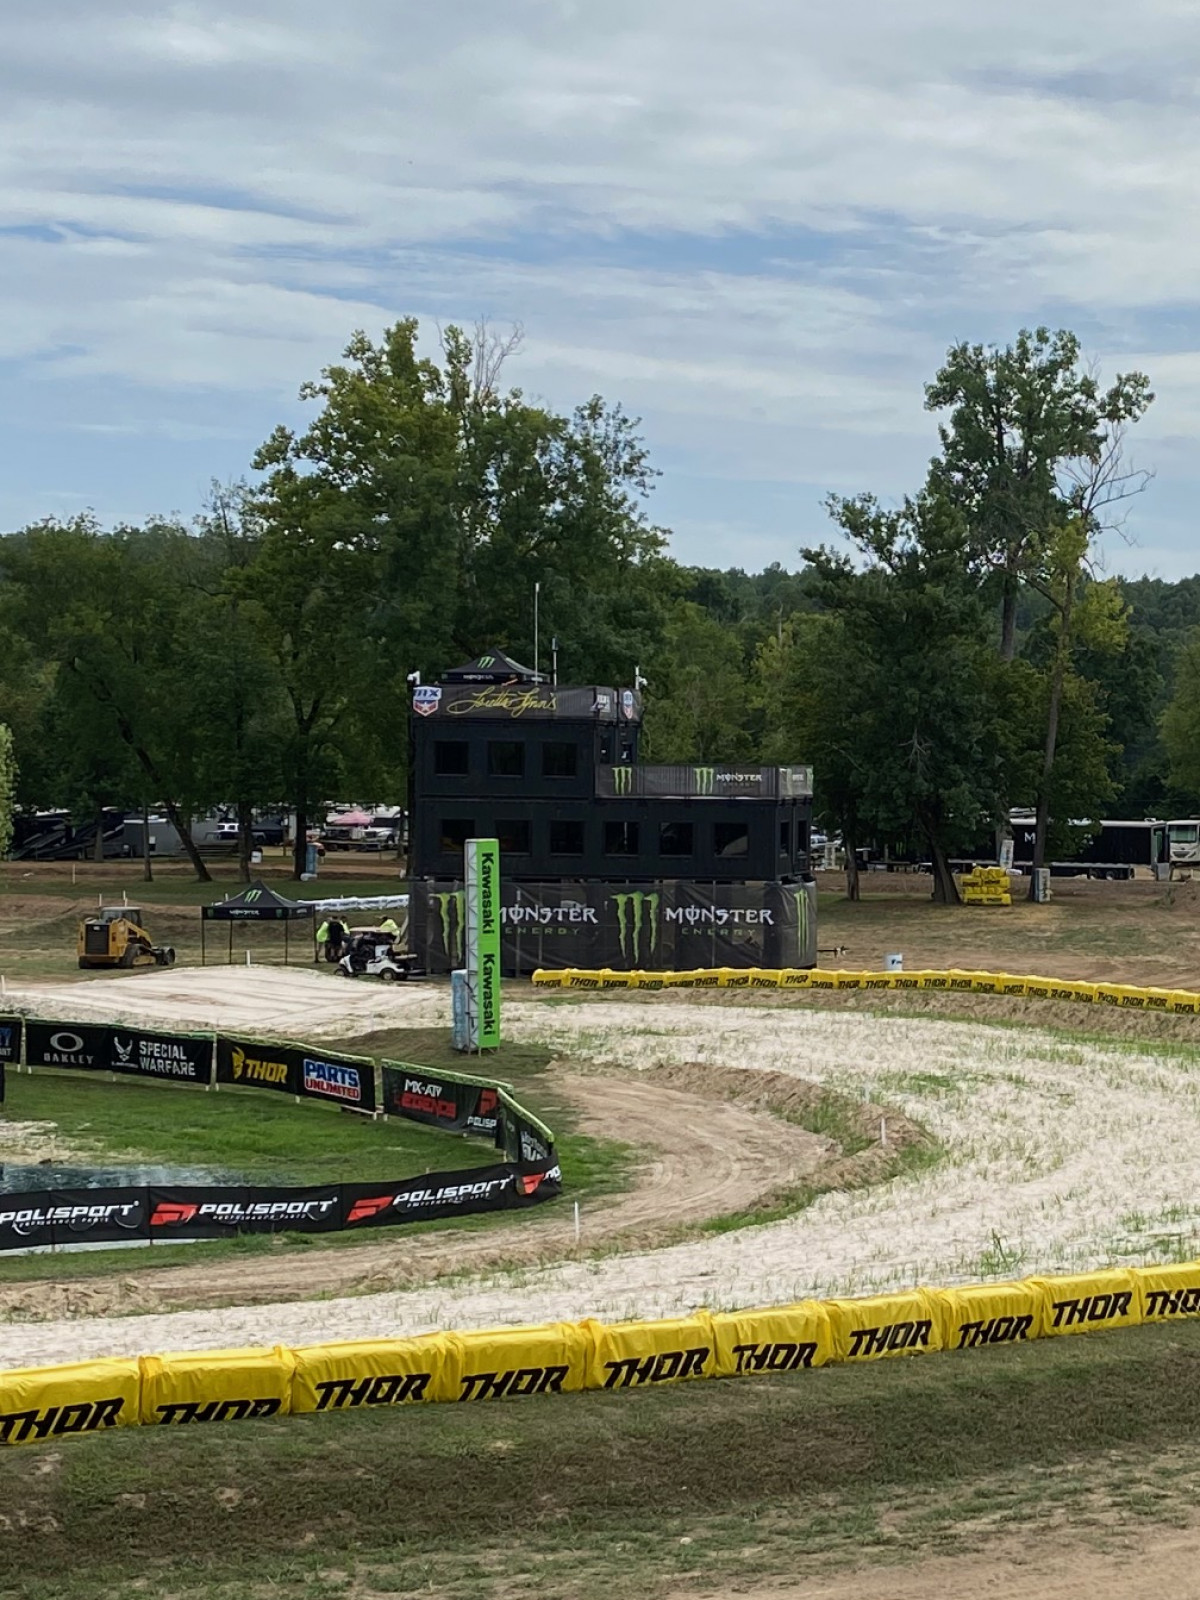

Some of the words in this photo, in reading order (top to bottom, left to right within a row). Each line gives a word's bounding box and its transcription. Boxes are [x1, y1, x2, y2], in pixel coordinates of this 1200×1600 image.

[717, 773, 762, 782] MONSTER
[481, 852, 495, 935] Kawasaki
[665, 904, 775, 926] MONSTER
[505, 927, 581, 935] ENERGY
[681, 928, 756, 936] ENERGY
[570, 977, 598, 987] THOR
[694, 977, 718, 986] THOR
[751, 978, 777, 987] THOR
[786, 975, 808, 984] THOR
[865, 980, 890, 989] THOR
[894, 980, 918, 988] THOR
[923, 979, 947, 988] THOR
[1003, 985, 1024, 994] THOR
[482, 953, 496, 1036] Kawasaki
[1122, 996, 1144, 1006] THOR
[44, 1052, 94, 1064] OAKLEY
[139, 1041, 188, 1060] SPECIAL
[139, 1056, 197, 1076] WARFARE
[245, 1059, 288, 1084] THOR
[306, 1061, 359, 1089] PARTS
[306, 1079, 359, 1099] UNLIMITED
[393, 1177, 512, 1206] POLISPORT
[0, 1204, 133, 1224] POLISPORT
[199, 1200, 333, 1215] POLISPORT
[1052, 1291, 1133, 1327] THOR
[848, 1319, 933, 1357] THOR
[957, 1315, 1034, 1350] THOR
[604, 1347, 711, 1388] THOR
[732, 1342, 818, 1373] THOR
[315, 1373, 432, 1409] THOR
[458, 1365, 570, 1402] THOR
[0, 1397, 125, 1442] THOR
